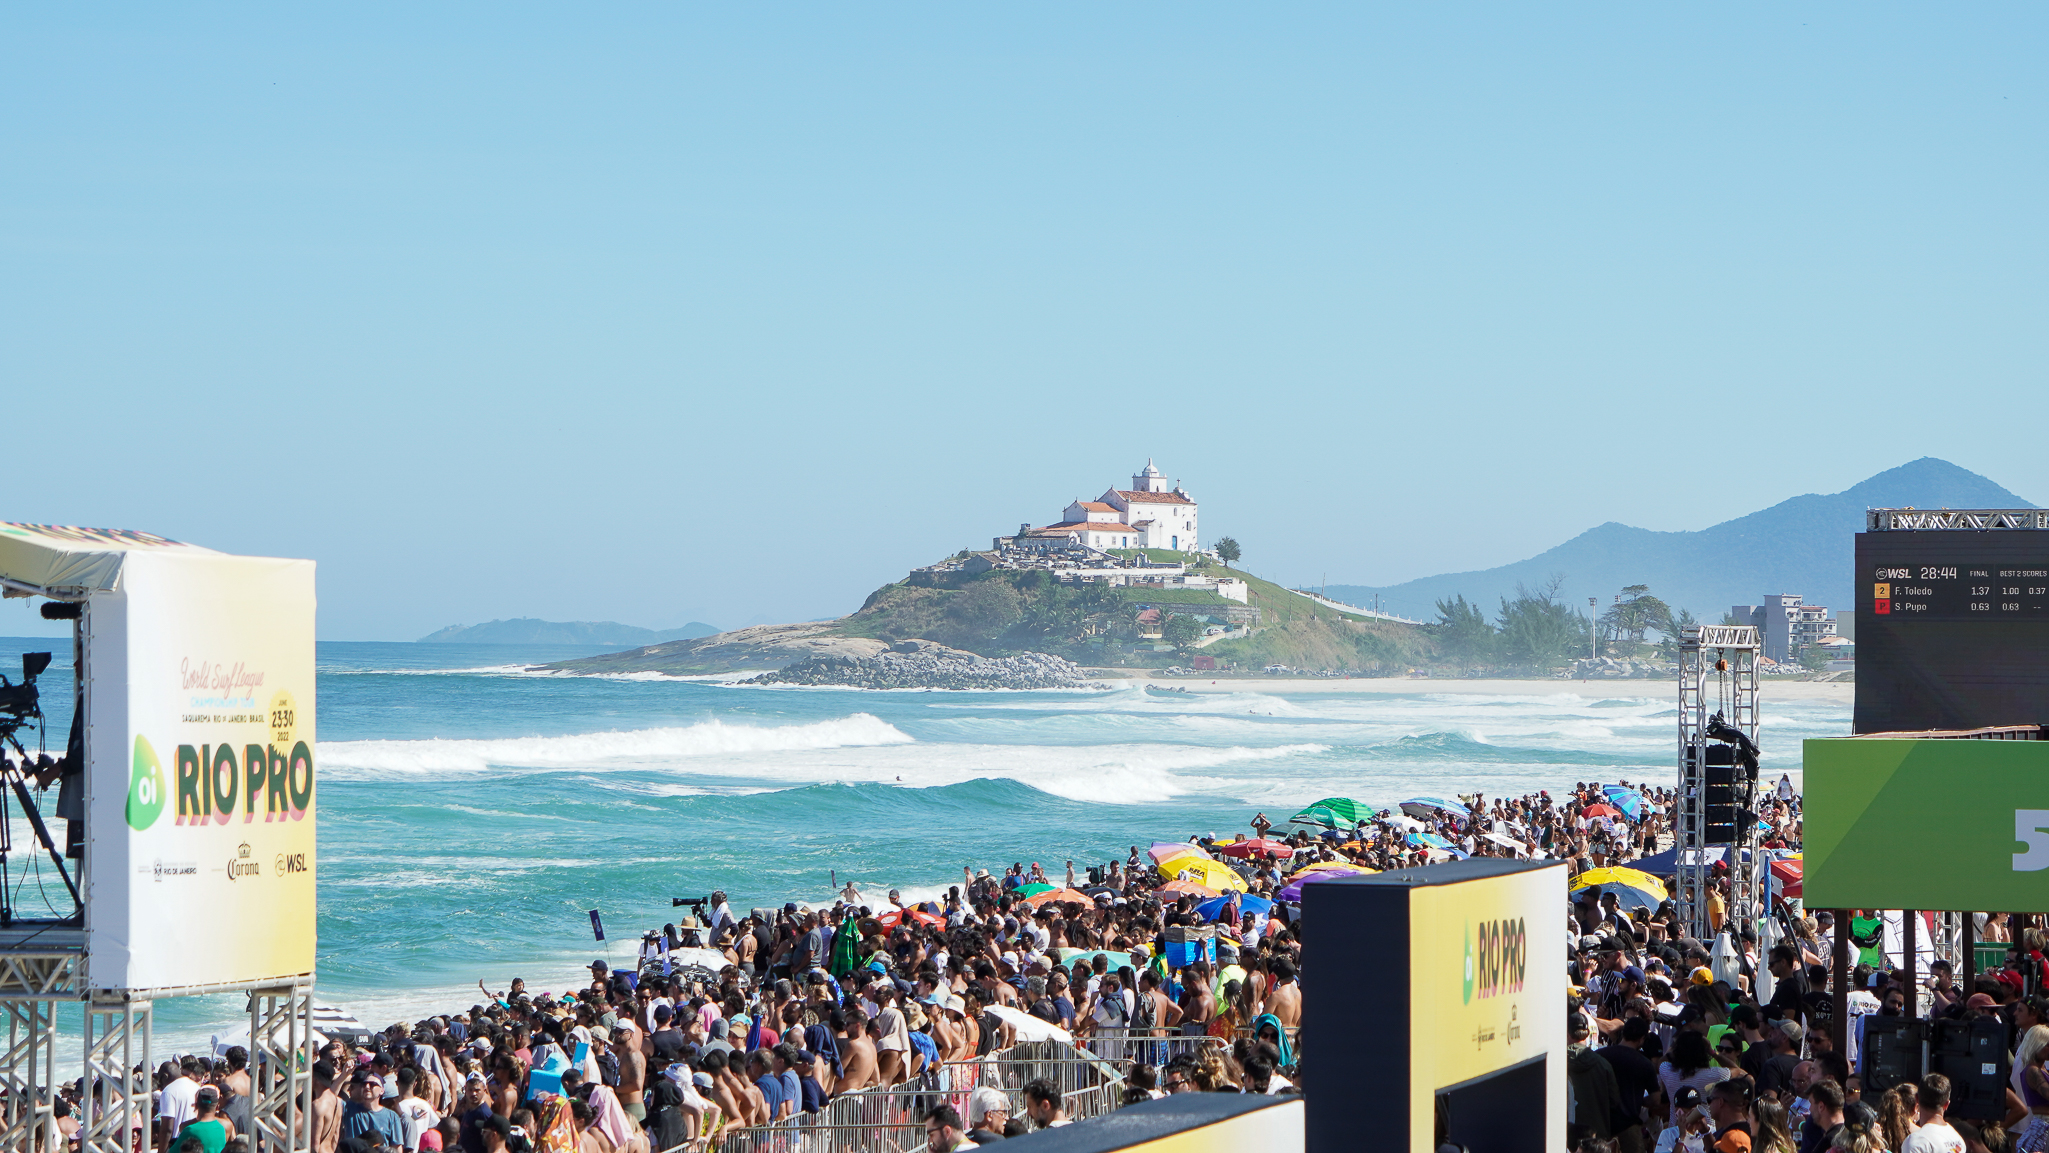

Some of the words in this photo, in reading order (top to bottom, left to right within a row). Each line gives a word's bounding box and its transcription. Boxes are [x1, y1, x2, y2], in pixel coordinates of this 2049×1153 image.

[1887, 568, 1912, 579] WSL
[1920, 566, 1957, 580] 28:44
[1894, 587, 1902, 595] F.
[1904, 587, 1933, 595] Toledo
[1971, 587, 1990, 595] 1.37
[2002, 587, 2020, 595] 1.00
[2028, 587, 2046, 595] 0.37
[1879, 602, 1886, 610] P
[1894, 602, 1903, 611] S.
[1905, 602, 1927, 612] Pupo
[1971, 602, 1990, 611] 0.63
[2002, 602, 2020, 611] 0.63
[181, 656, 211, 690] World
[211, 661, 239, 700] Surf
[234, 661, 264, 701] League
[182, 714, 211, 723] SAQUAREMA
[213, 714, 222, 723] RIO
[228, 714, 247, 723] JANEIRO
[249, 714, 265, 723] BRASIL
[277, 731, 289, 742] 2022
[138, 765, 157, 805] oi
[174, 742, 239, 826] RIO
[242, 740, 313, 824] PRO
[286, 853, 307, 873] WSL
[179, 867, 197, 875] JANEIRO
[227, 857, 260, 883] Corona
[1465, 944, 1473, 982] oi
[1478, 918, 1500, 1000] RIO
[1502, 916, 1526, 995] PRO
